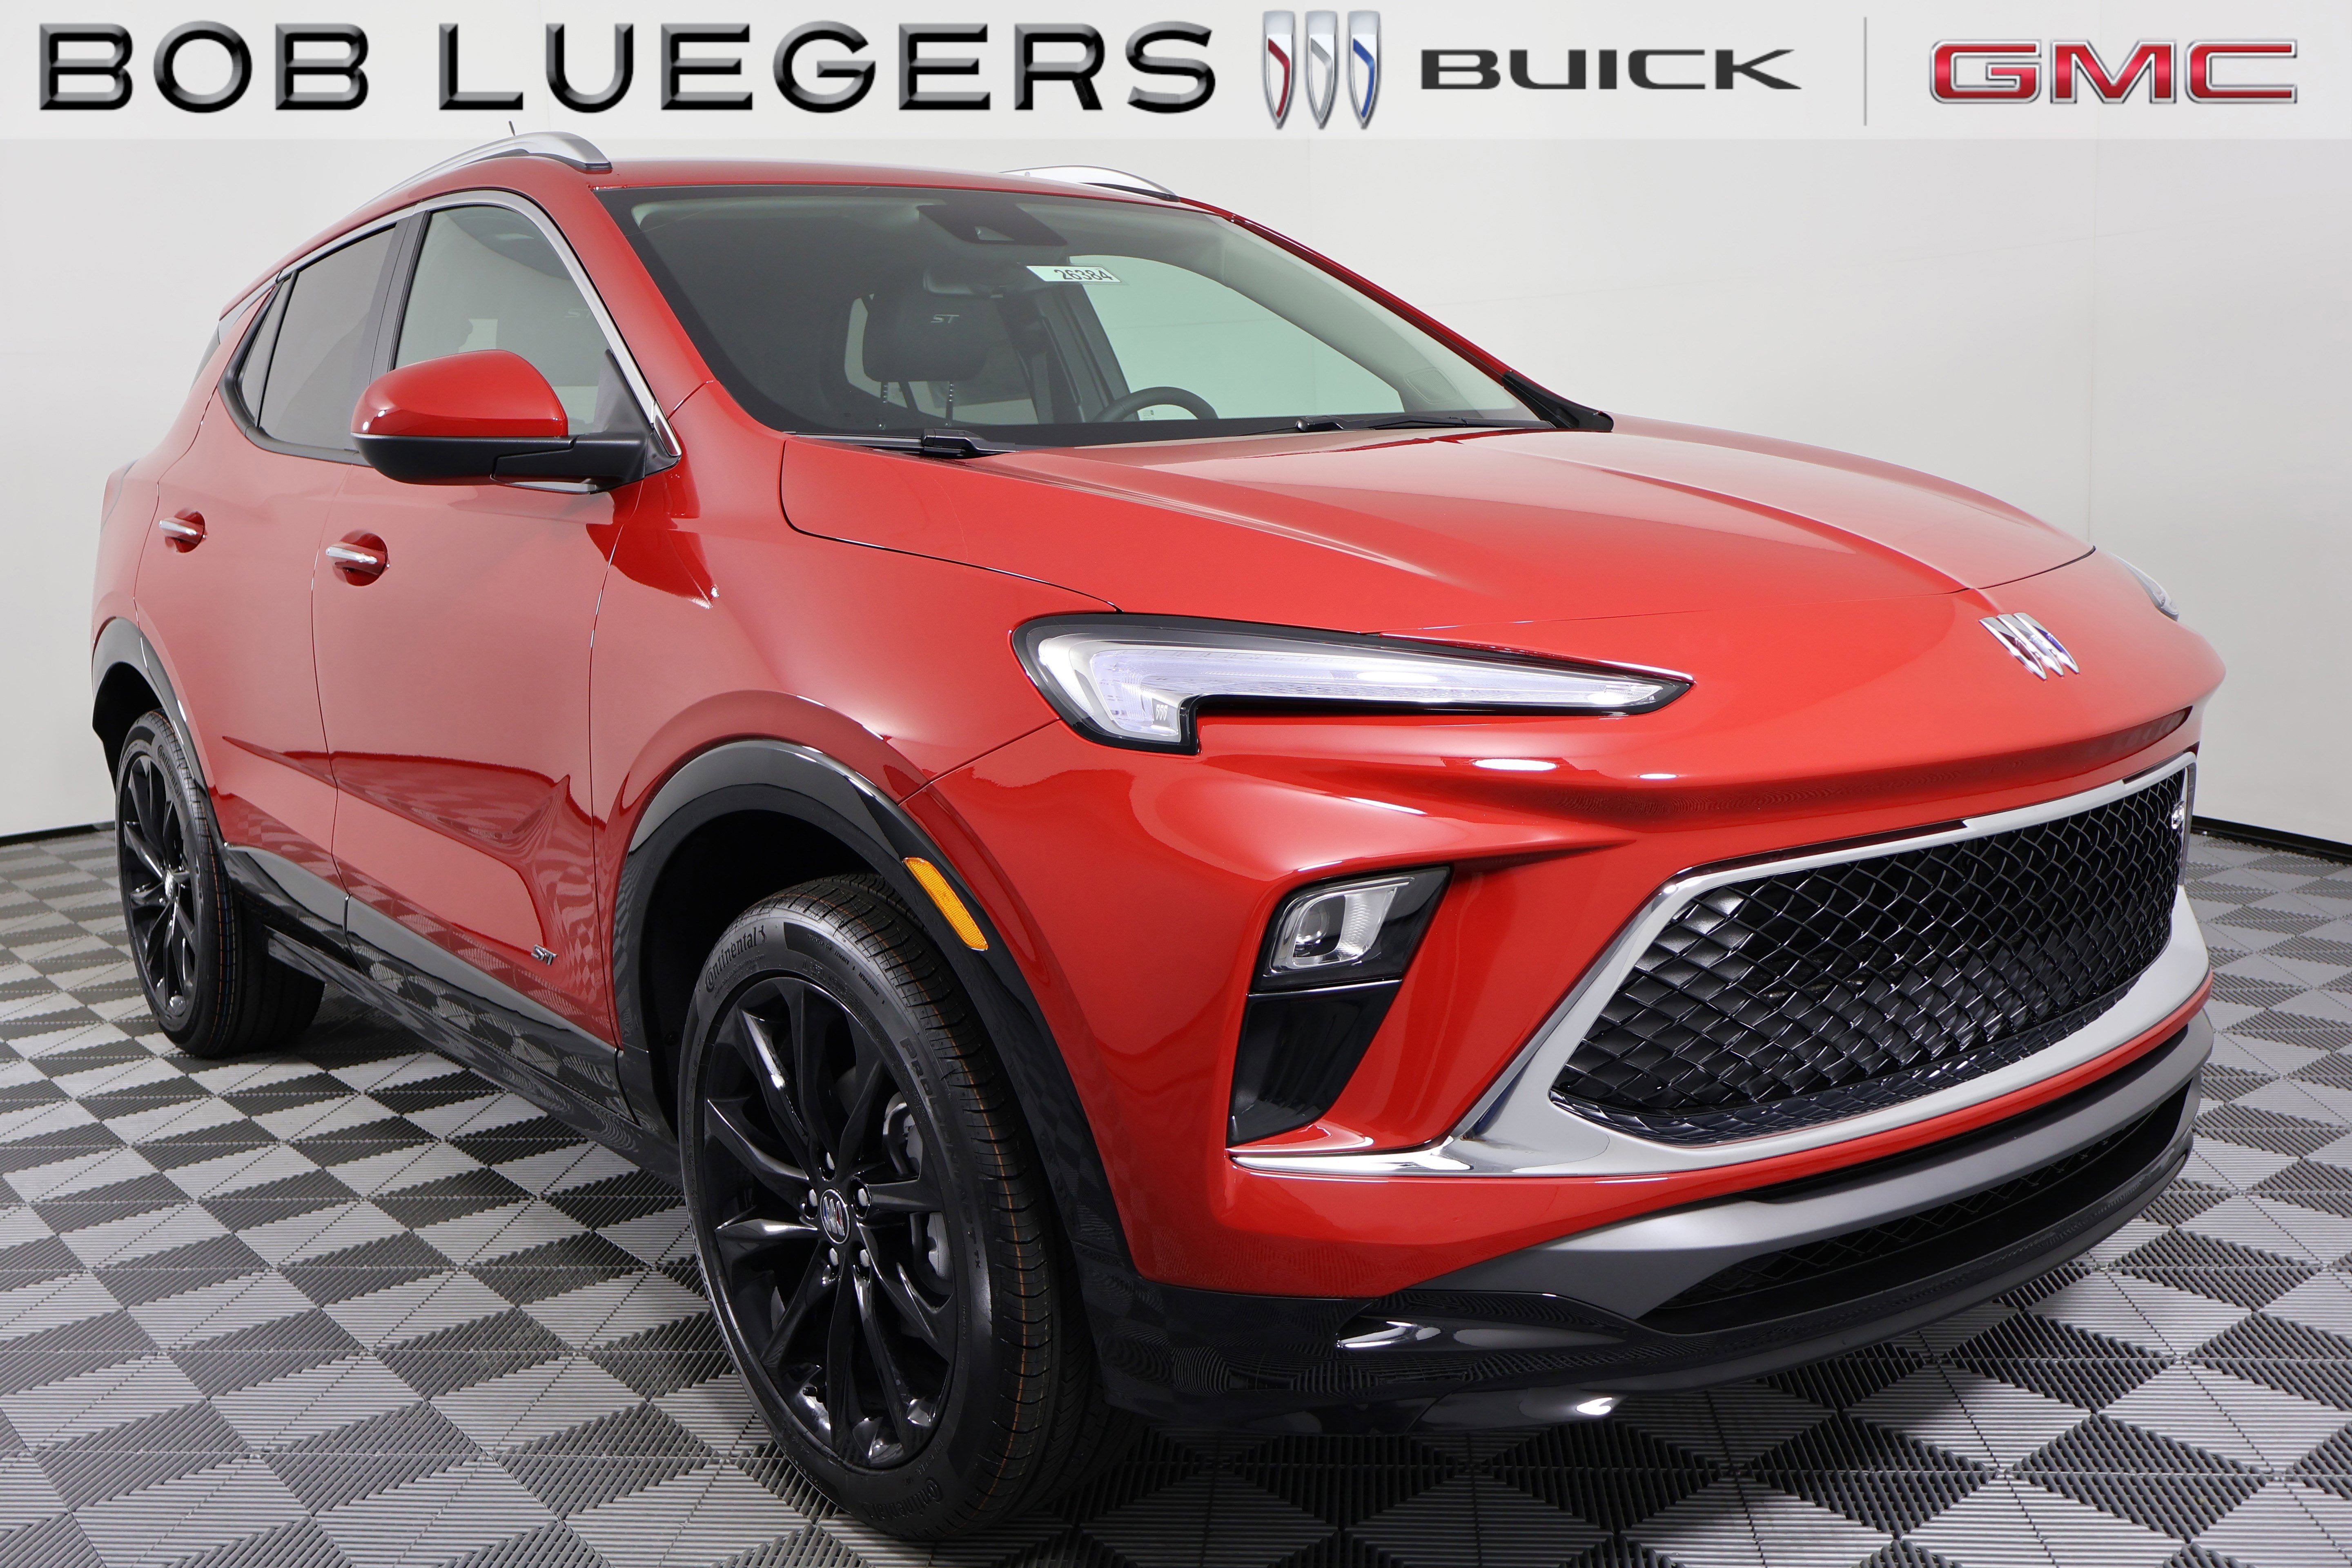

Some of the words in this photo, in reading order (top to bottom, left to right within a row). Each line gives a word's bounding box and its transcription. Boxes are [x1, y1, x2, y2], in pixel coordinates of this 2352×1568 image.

[1054, 269, 1113, 281] 26384
[931, 314, 960, 323] ST
[531, 944, 558, 965] ST
[705, 927, 758, 993] Continental
